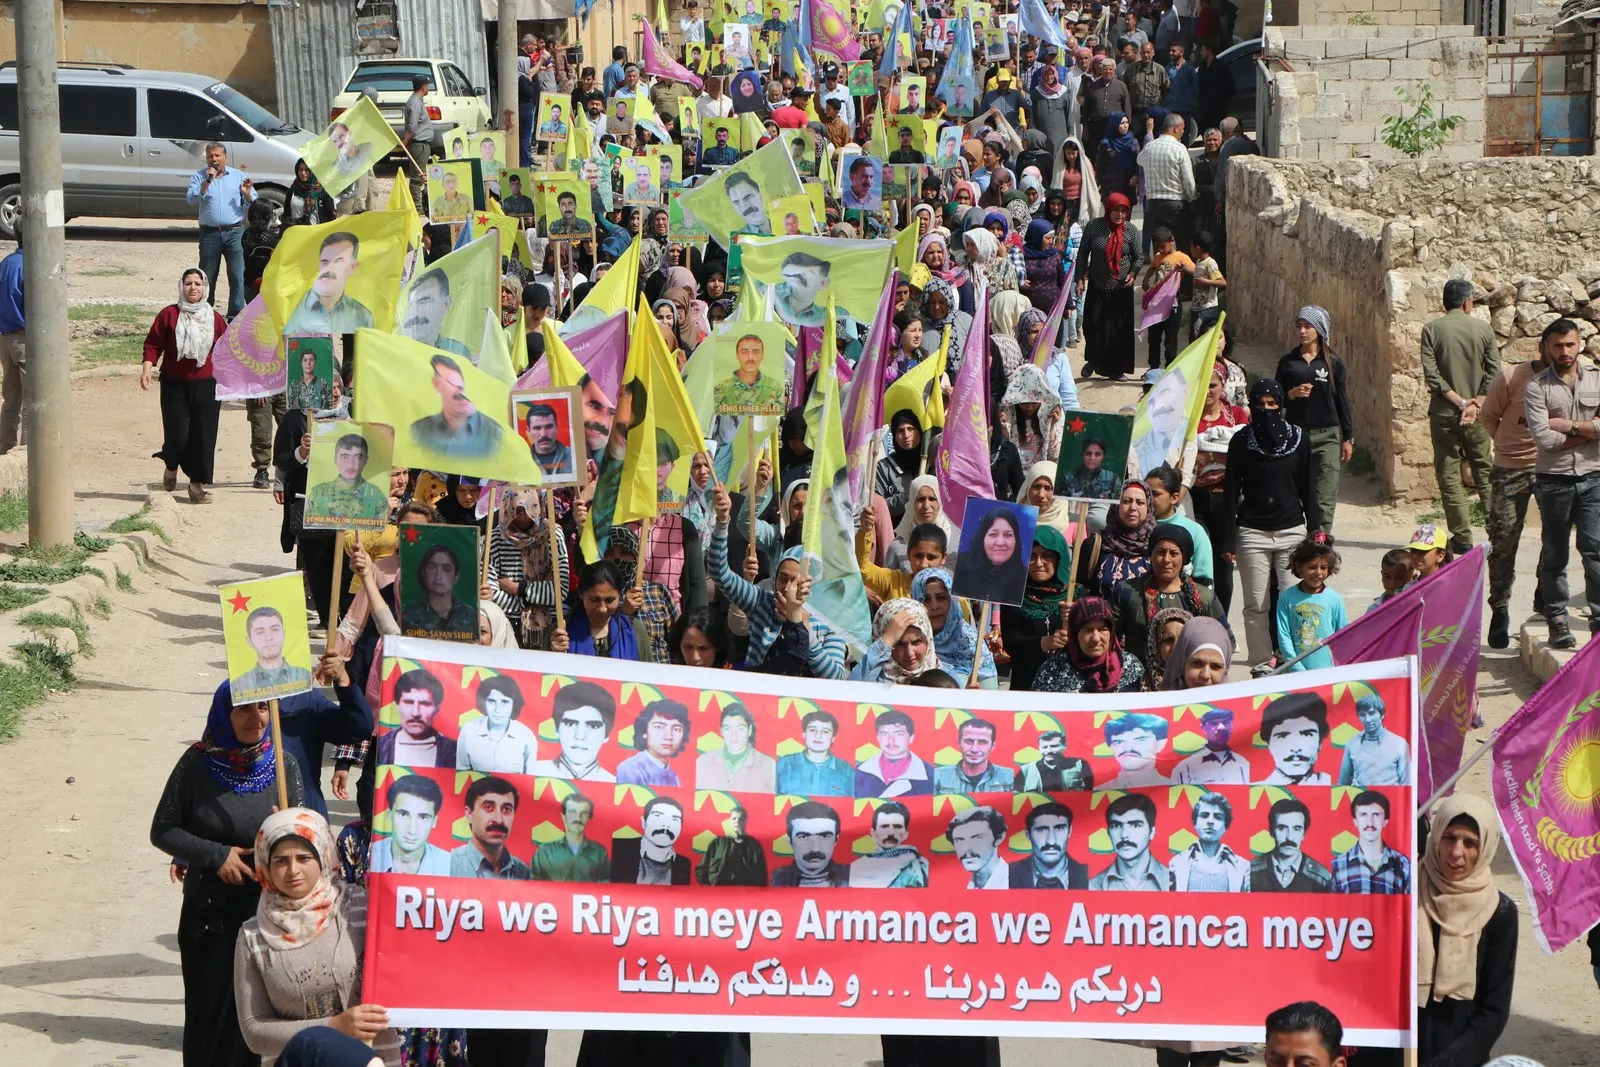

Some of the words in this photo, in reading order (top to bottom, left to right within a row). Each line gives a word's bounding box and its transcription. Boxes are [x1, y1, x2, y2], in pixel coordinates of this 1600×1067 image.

[1520, 823, 1537, 852] Azad
[1533, 847, 1543, 865] Ya
[395, 885, 484, 941] Riya
[497, 898, 560, 933] we
[572, 893, 661, 946] Riya
[673, 906, 784, 949] meye
[795, 898, 979, 944] Armanca
[991, 912, 1052, 944] we
[1064, 902, 1249, 948] Armanca
[1263, 915, 1375, 960] meye
[617, 954, 721, 995] هدفنا
[727, 957, 835, 1008] هدفكم
[924, 963, 1007, 1014] دربنا
[1068, 964, 1163, 1017] دربكم
